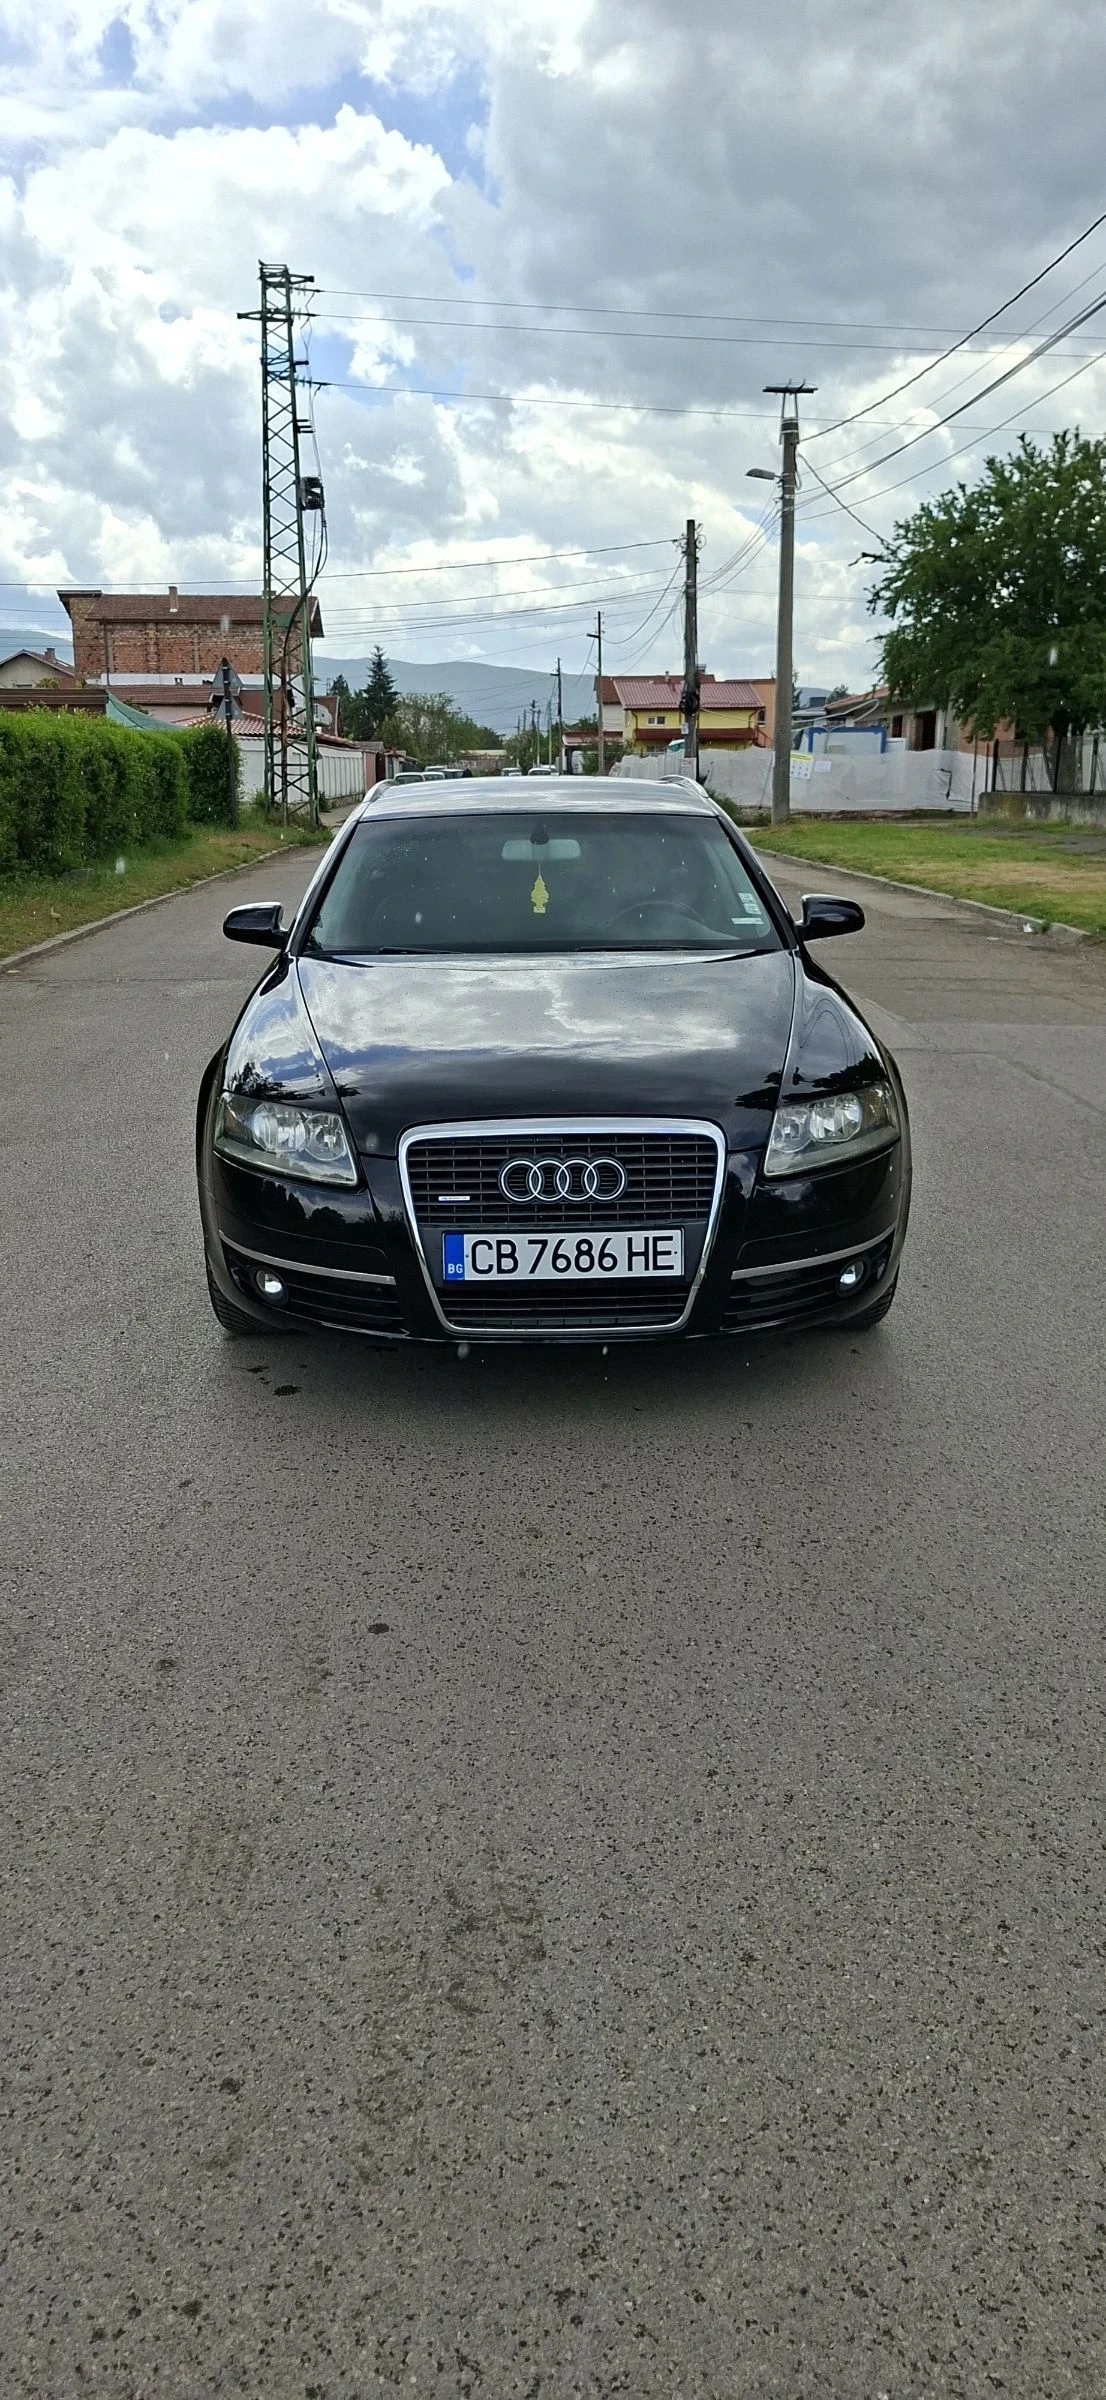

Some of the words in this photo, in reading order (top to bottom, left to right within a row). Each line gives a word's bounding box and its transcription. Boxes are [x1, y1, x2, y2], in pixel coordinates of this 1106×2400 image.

[471, 1239, 518, 1275] CB
[527, 1238, 618, 1274] 7686
[627, 1236, 674, 1271] HE
[448, 1263, 463, 1274] BG
